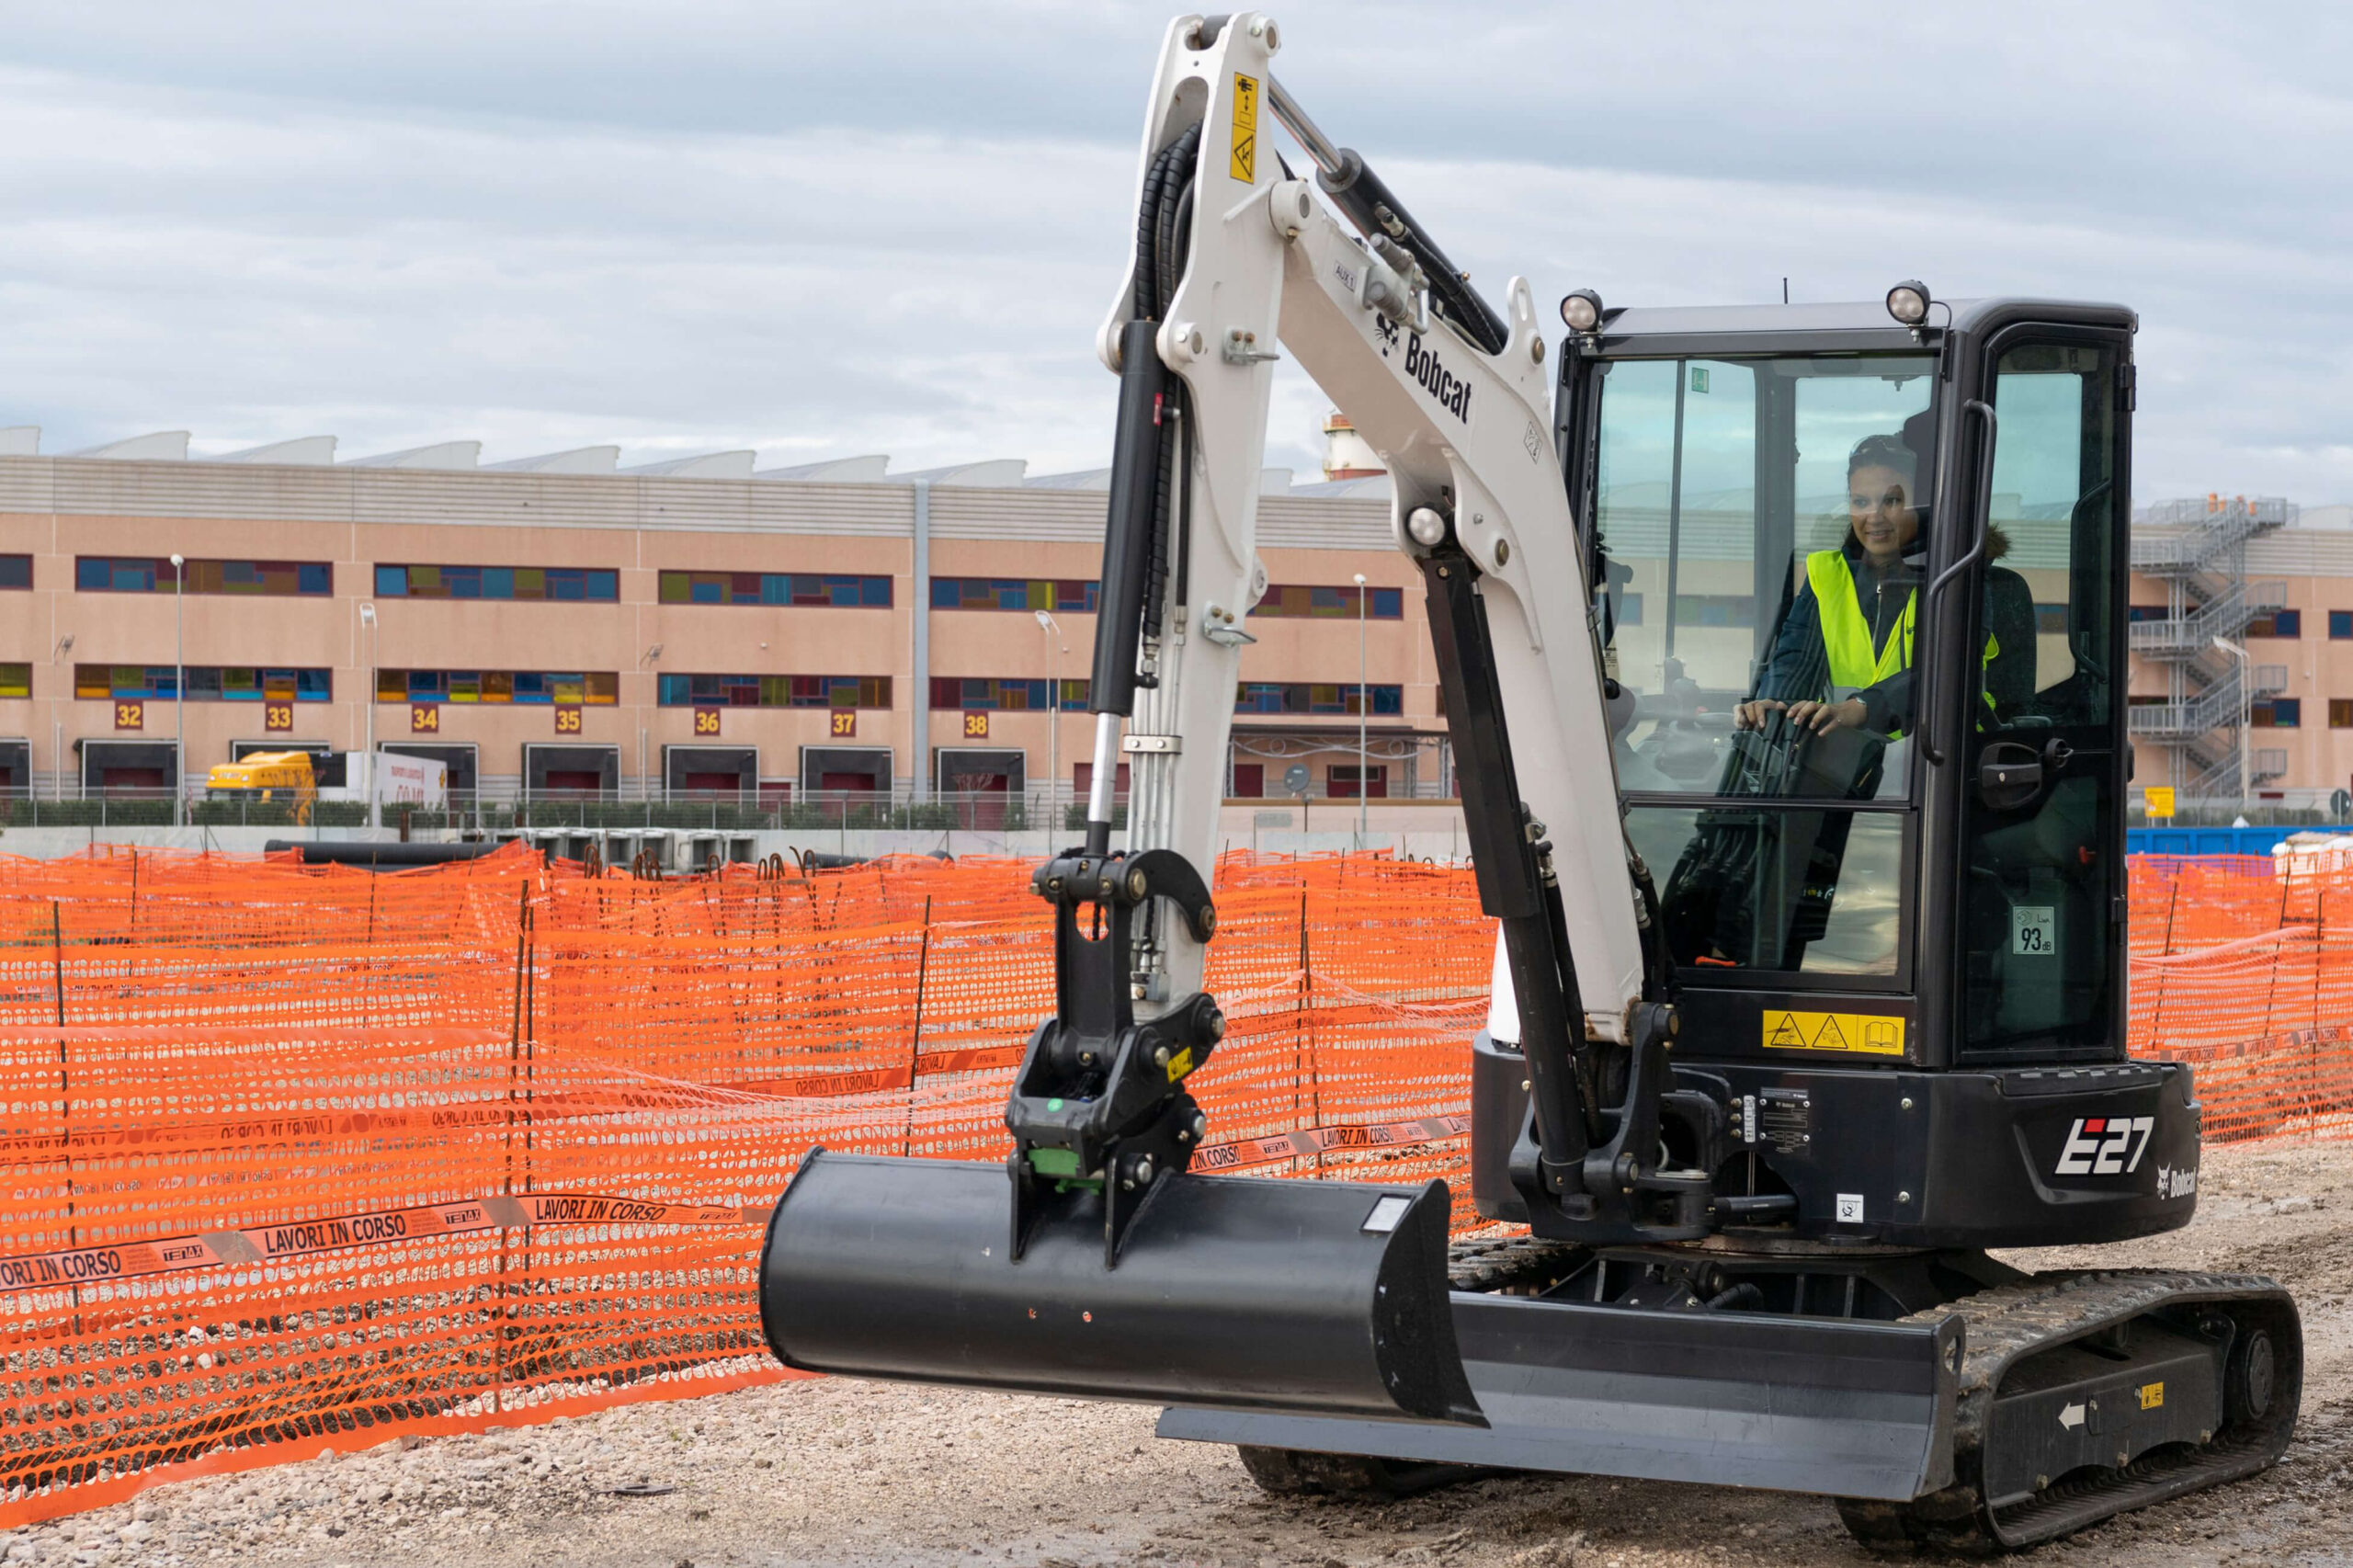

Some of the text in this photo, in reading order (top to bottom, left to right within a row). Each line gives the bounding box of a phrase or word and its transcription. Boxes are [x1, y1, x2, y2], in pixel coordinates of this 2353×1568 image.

[1335, 265, 1349, 285] AUX
[1404, 332, 1472, 425] Bobcat
[118, 705, 142, 727] 32
[267, 708, 291, 728] 33
[414, 709, 438, 730] 34
[557, 710, 581, 732] 35
[697, 712, 719, 733] 36
[833, 714, 854, 733] 37
[966, 715, 987, 734] 38
[2021, 927, 2052, 950] 93 dB
[1322, 1125, 1394, 1148] LAVORI IN CORSO
[2054, 1117, 2154, 1174] E27
[1193, 1145, 1241, 1169] IN CORSO
[445, 1209, 481, 1225] TENAX
[536, 1199, 587, 1221] LAVORI
[586, 1201, 610, 1220] IN
[609, 1202, 666, 1221] CORSO
[265, 1221, 326, 1254] LAVORI
[327, 1221, 349, 1244] IN
[353, 1214, 406, 1242] CORSO
[163, 1244, 204, 1262] TENAX
[0, 1258, 36, 1287] ORI
[36, 1256, 60, 1282] IN
[62, 1250, 121, 1278] CORSO
